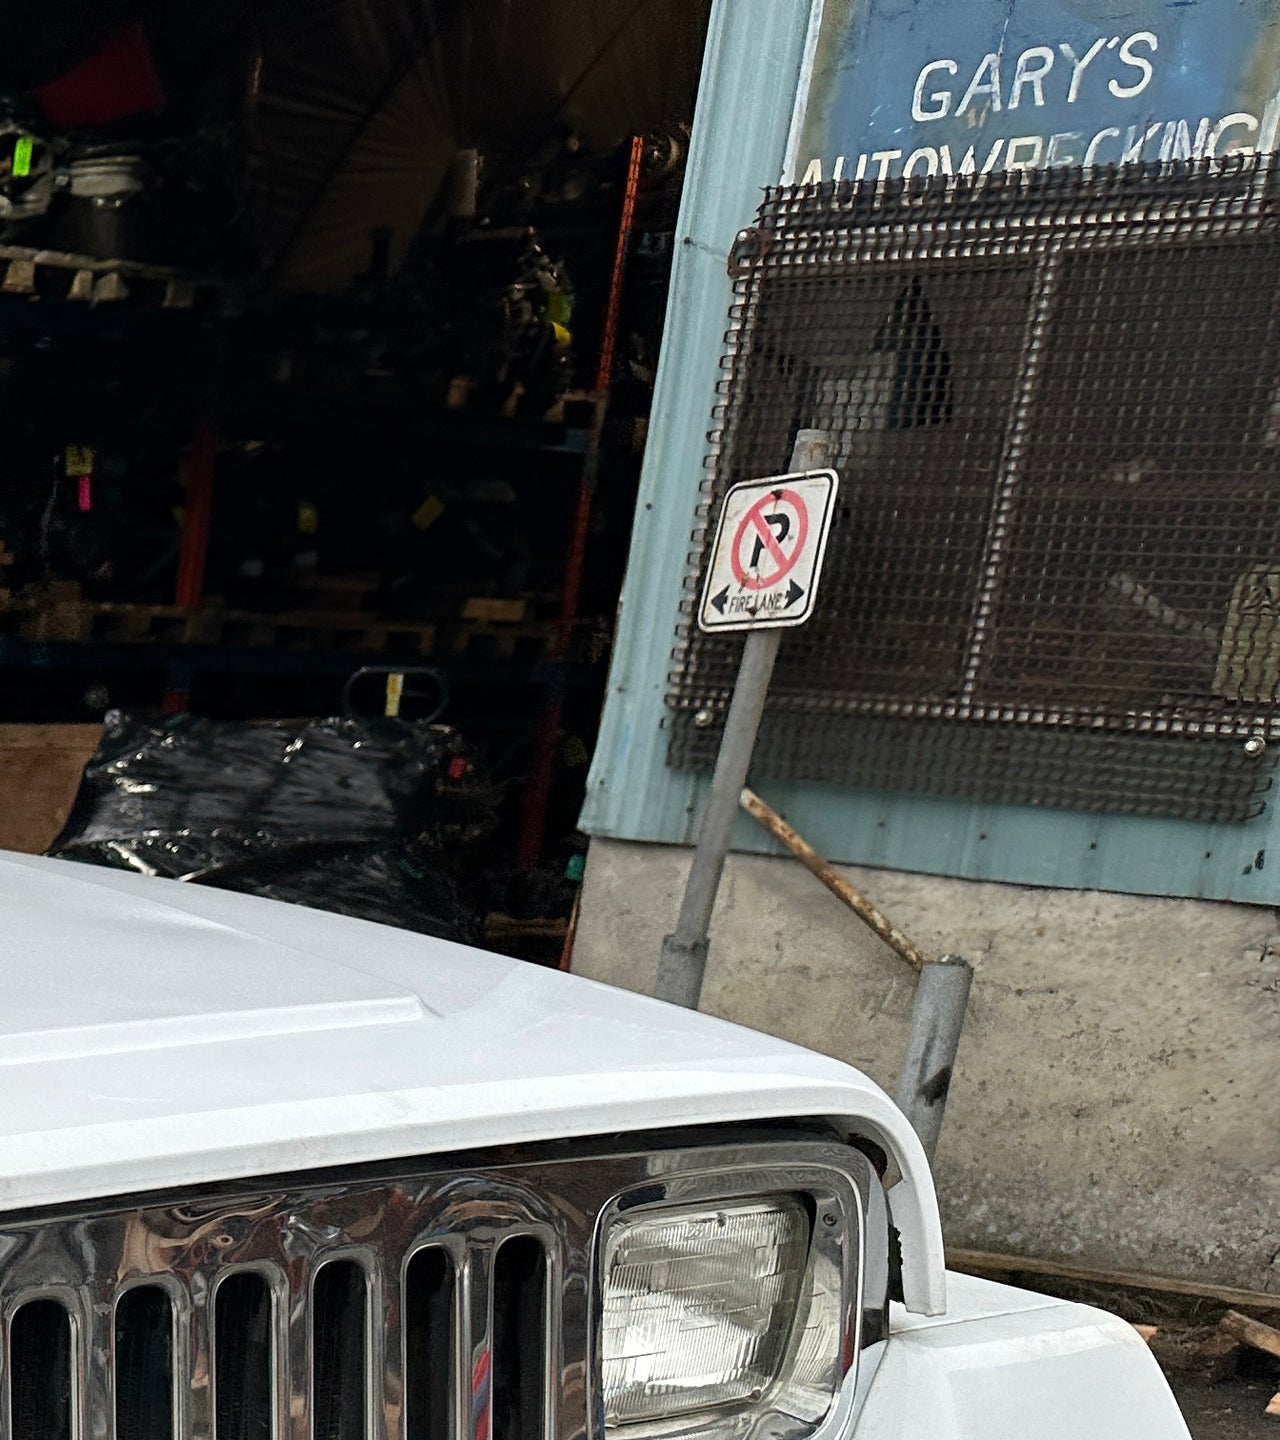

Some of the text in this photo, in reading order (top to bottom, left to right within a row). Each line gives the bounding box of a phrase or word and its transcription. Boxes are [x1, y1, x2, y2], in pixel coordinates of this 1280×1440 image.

[910, 31, 1158, 122] GARY'S
[728, 592, 783, 614] FIRE LANE
